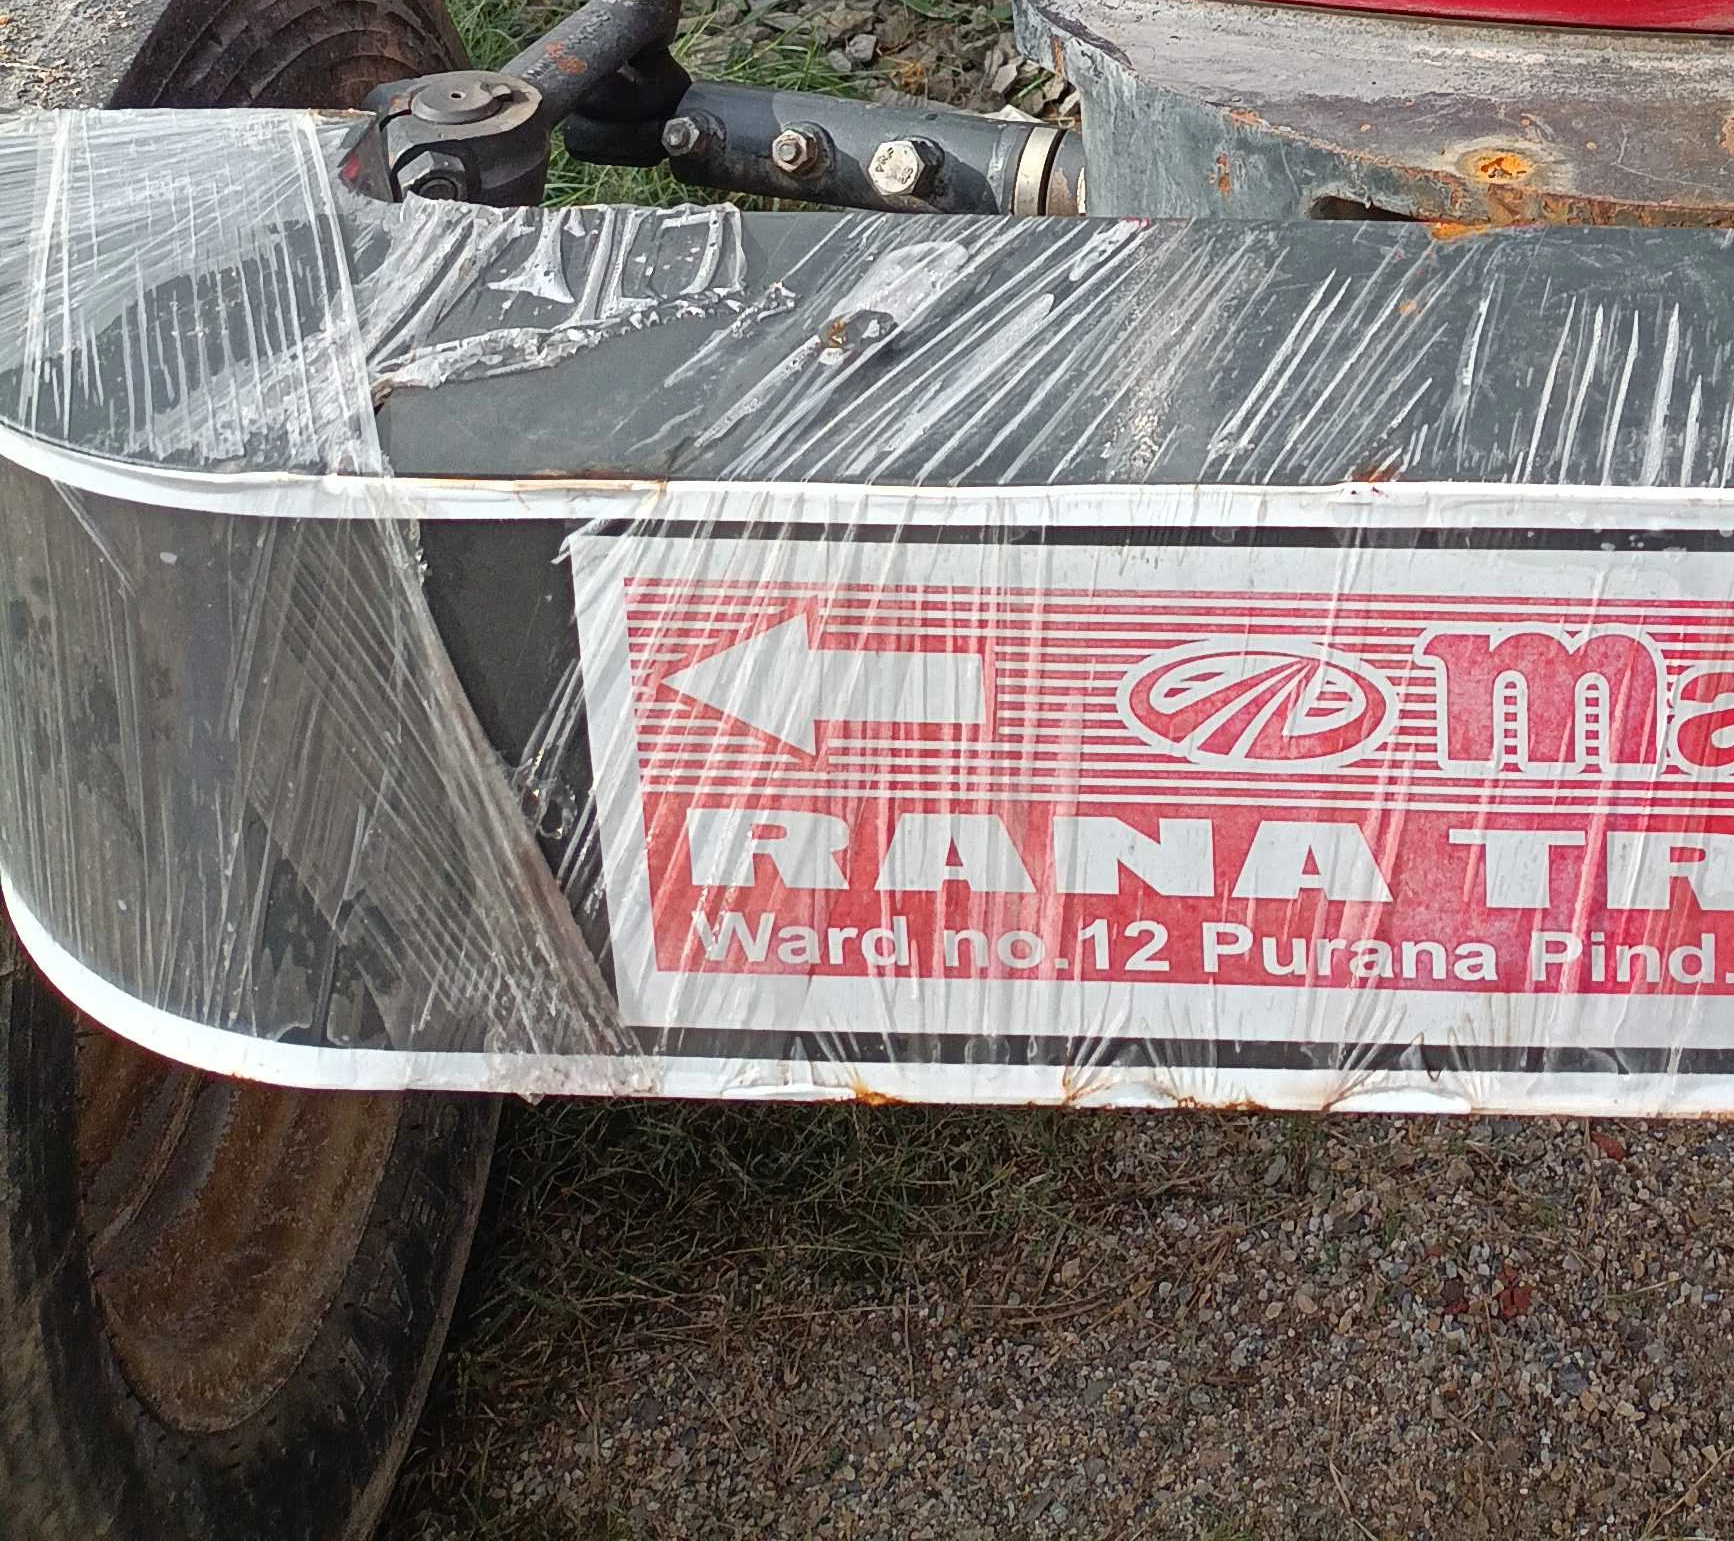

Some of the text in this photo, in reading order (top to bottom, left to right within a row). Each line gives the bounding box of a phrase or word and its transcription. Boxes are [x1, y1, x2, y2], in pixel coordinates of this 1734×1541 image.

[684, 807, 1394, 903] RANA
[689, 909, 910, 969] Ward
[942, 918, 1169, 975] no.12
[1202, 926, 1500, 984] Purana
